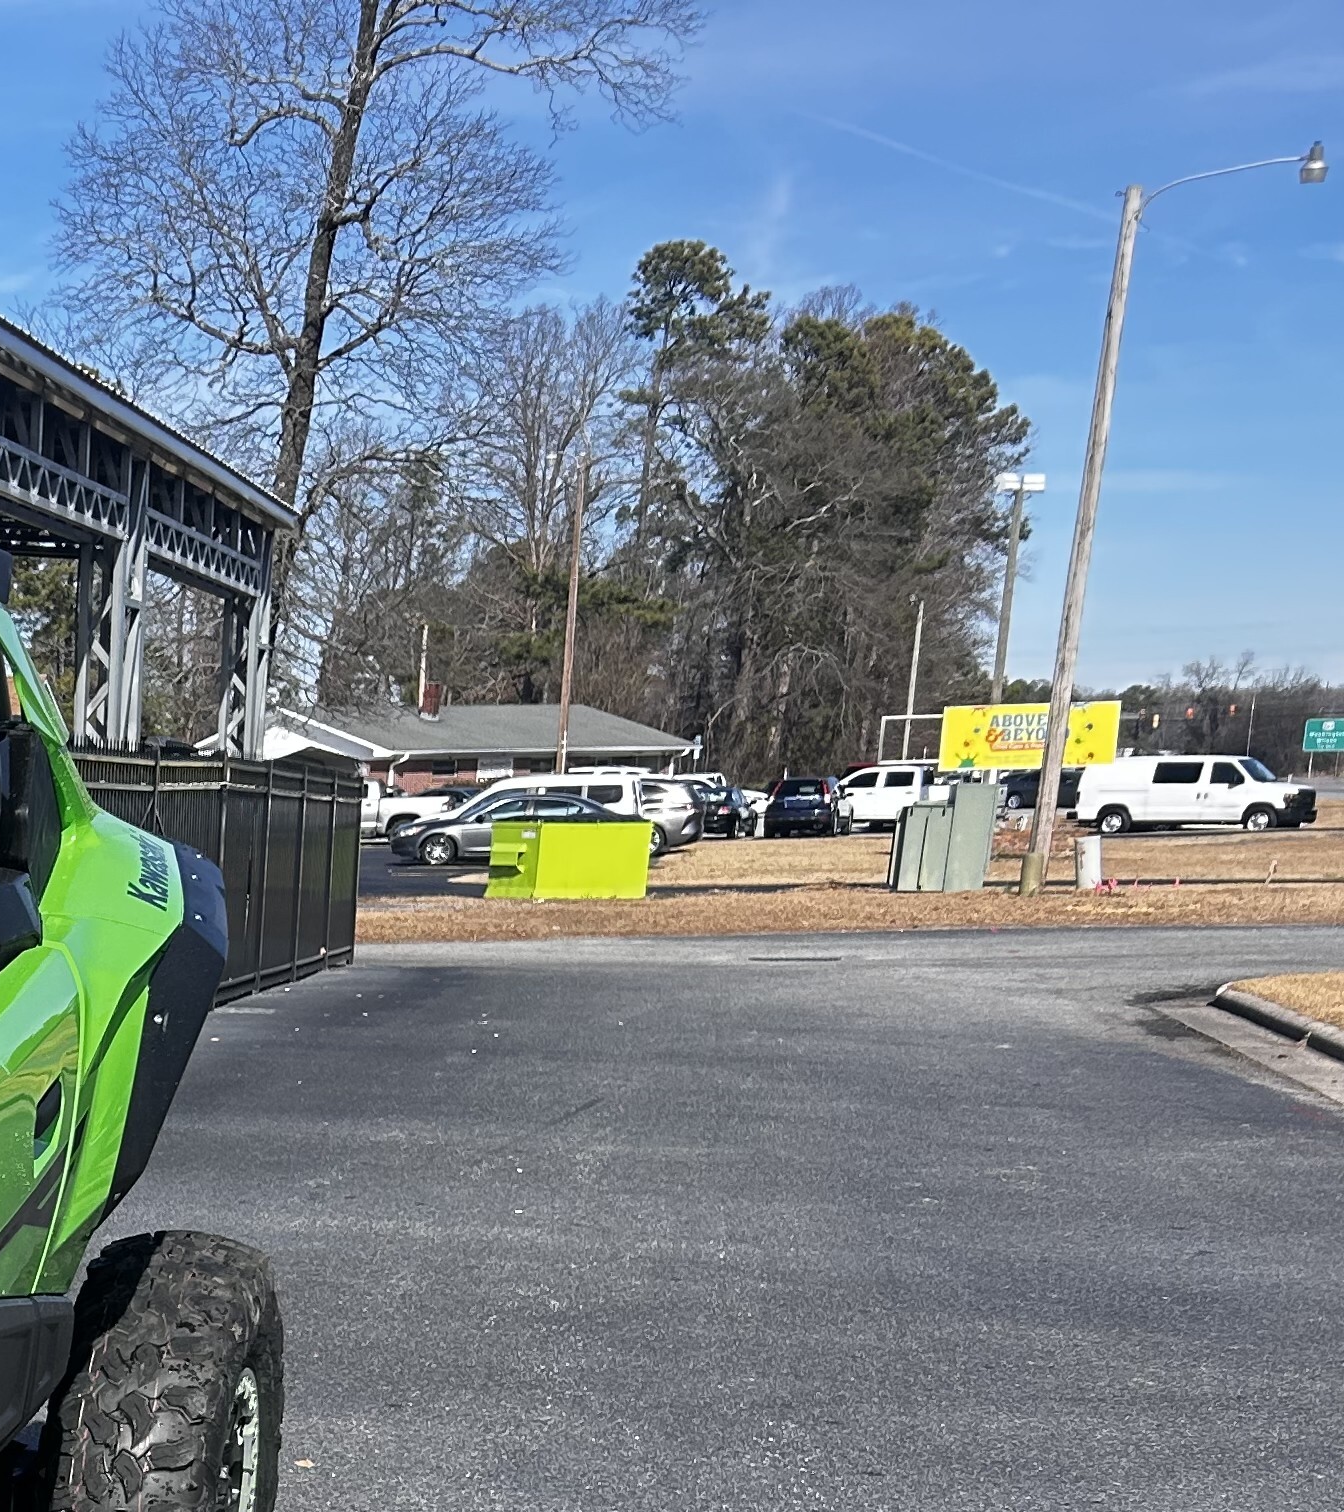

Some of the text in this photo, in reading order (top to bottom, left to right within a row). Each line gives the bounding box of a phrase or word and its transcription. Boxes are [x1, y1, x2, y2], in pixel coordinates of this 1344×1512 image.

[990, 713, 1048, 727] ABOVE
[1000, 727, 1070, 742] BEYO
[126, 828, 169, 912] Kawasaki
